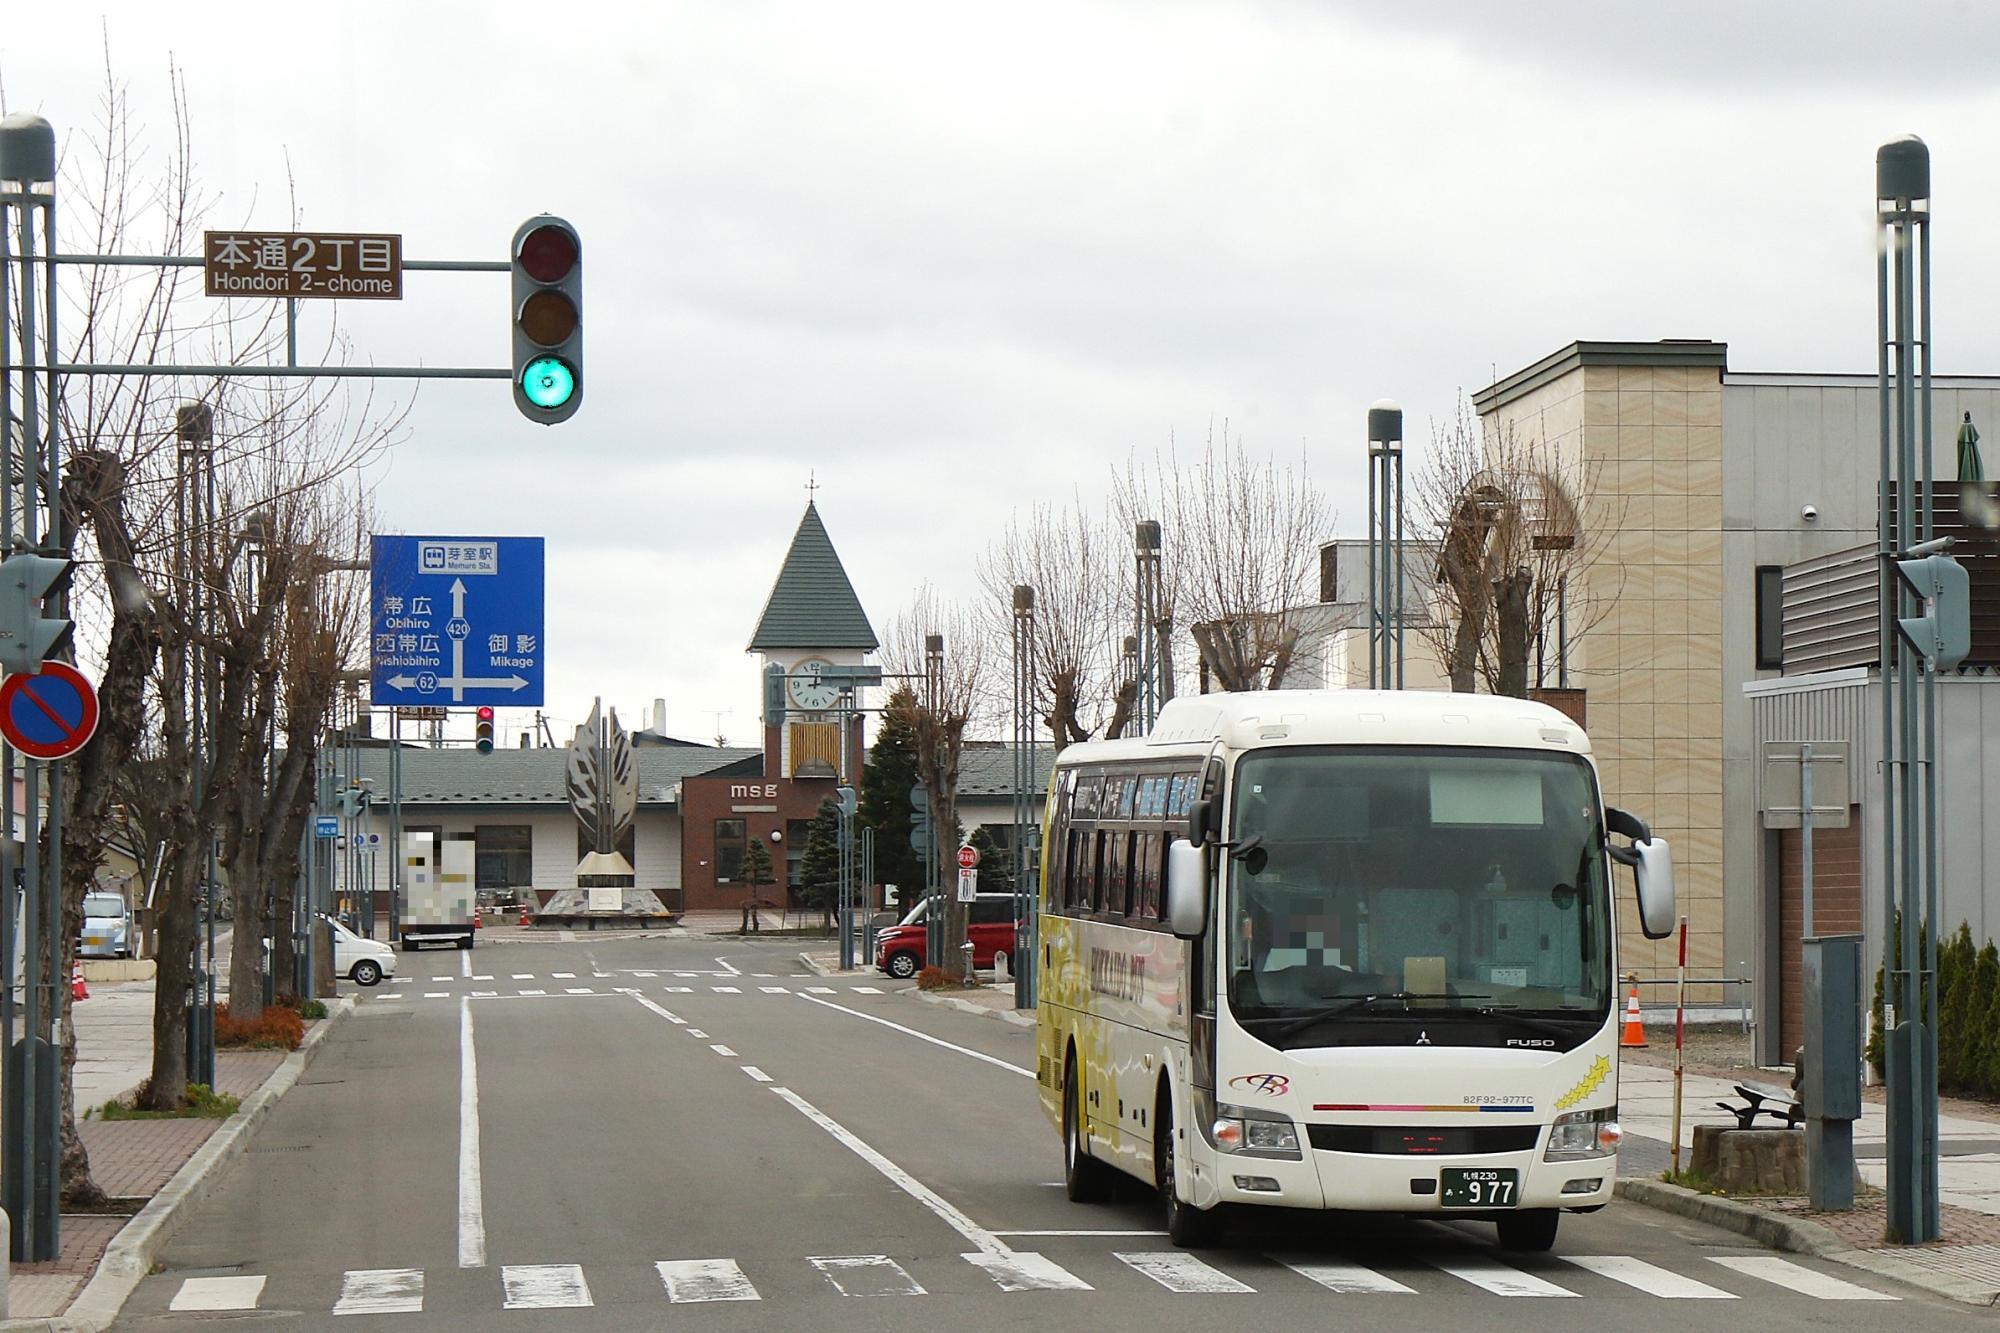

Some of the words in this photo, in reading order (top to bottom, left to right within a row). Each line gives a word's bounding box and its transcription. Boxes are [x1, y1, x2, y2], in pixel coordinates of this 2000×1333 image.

[214, 236, 390, 272] 本通2丁目
[214, 271, 289, 290] Hondori
[300, 273, 392, 292] 2-chome
[448, 548, 493, 560] 芽室駅
[384, 596, 432, 616] 帯広
[386, 617, 430, 629] Obihiro
[449, 623, 468, 635] 420
[376, 634, 440, 653] 西帯広
[488, 634, 536, 653] 御影
[490, 656, 534, 668] Mikage
[419, 677, 434, 689] 62
[731, 784, 778, 798] msg
[1463, 1095, 1534, 1104] 82F92-977TC
